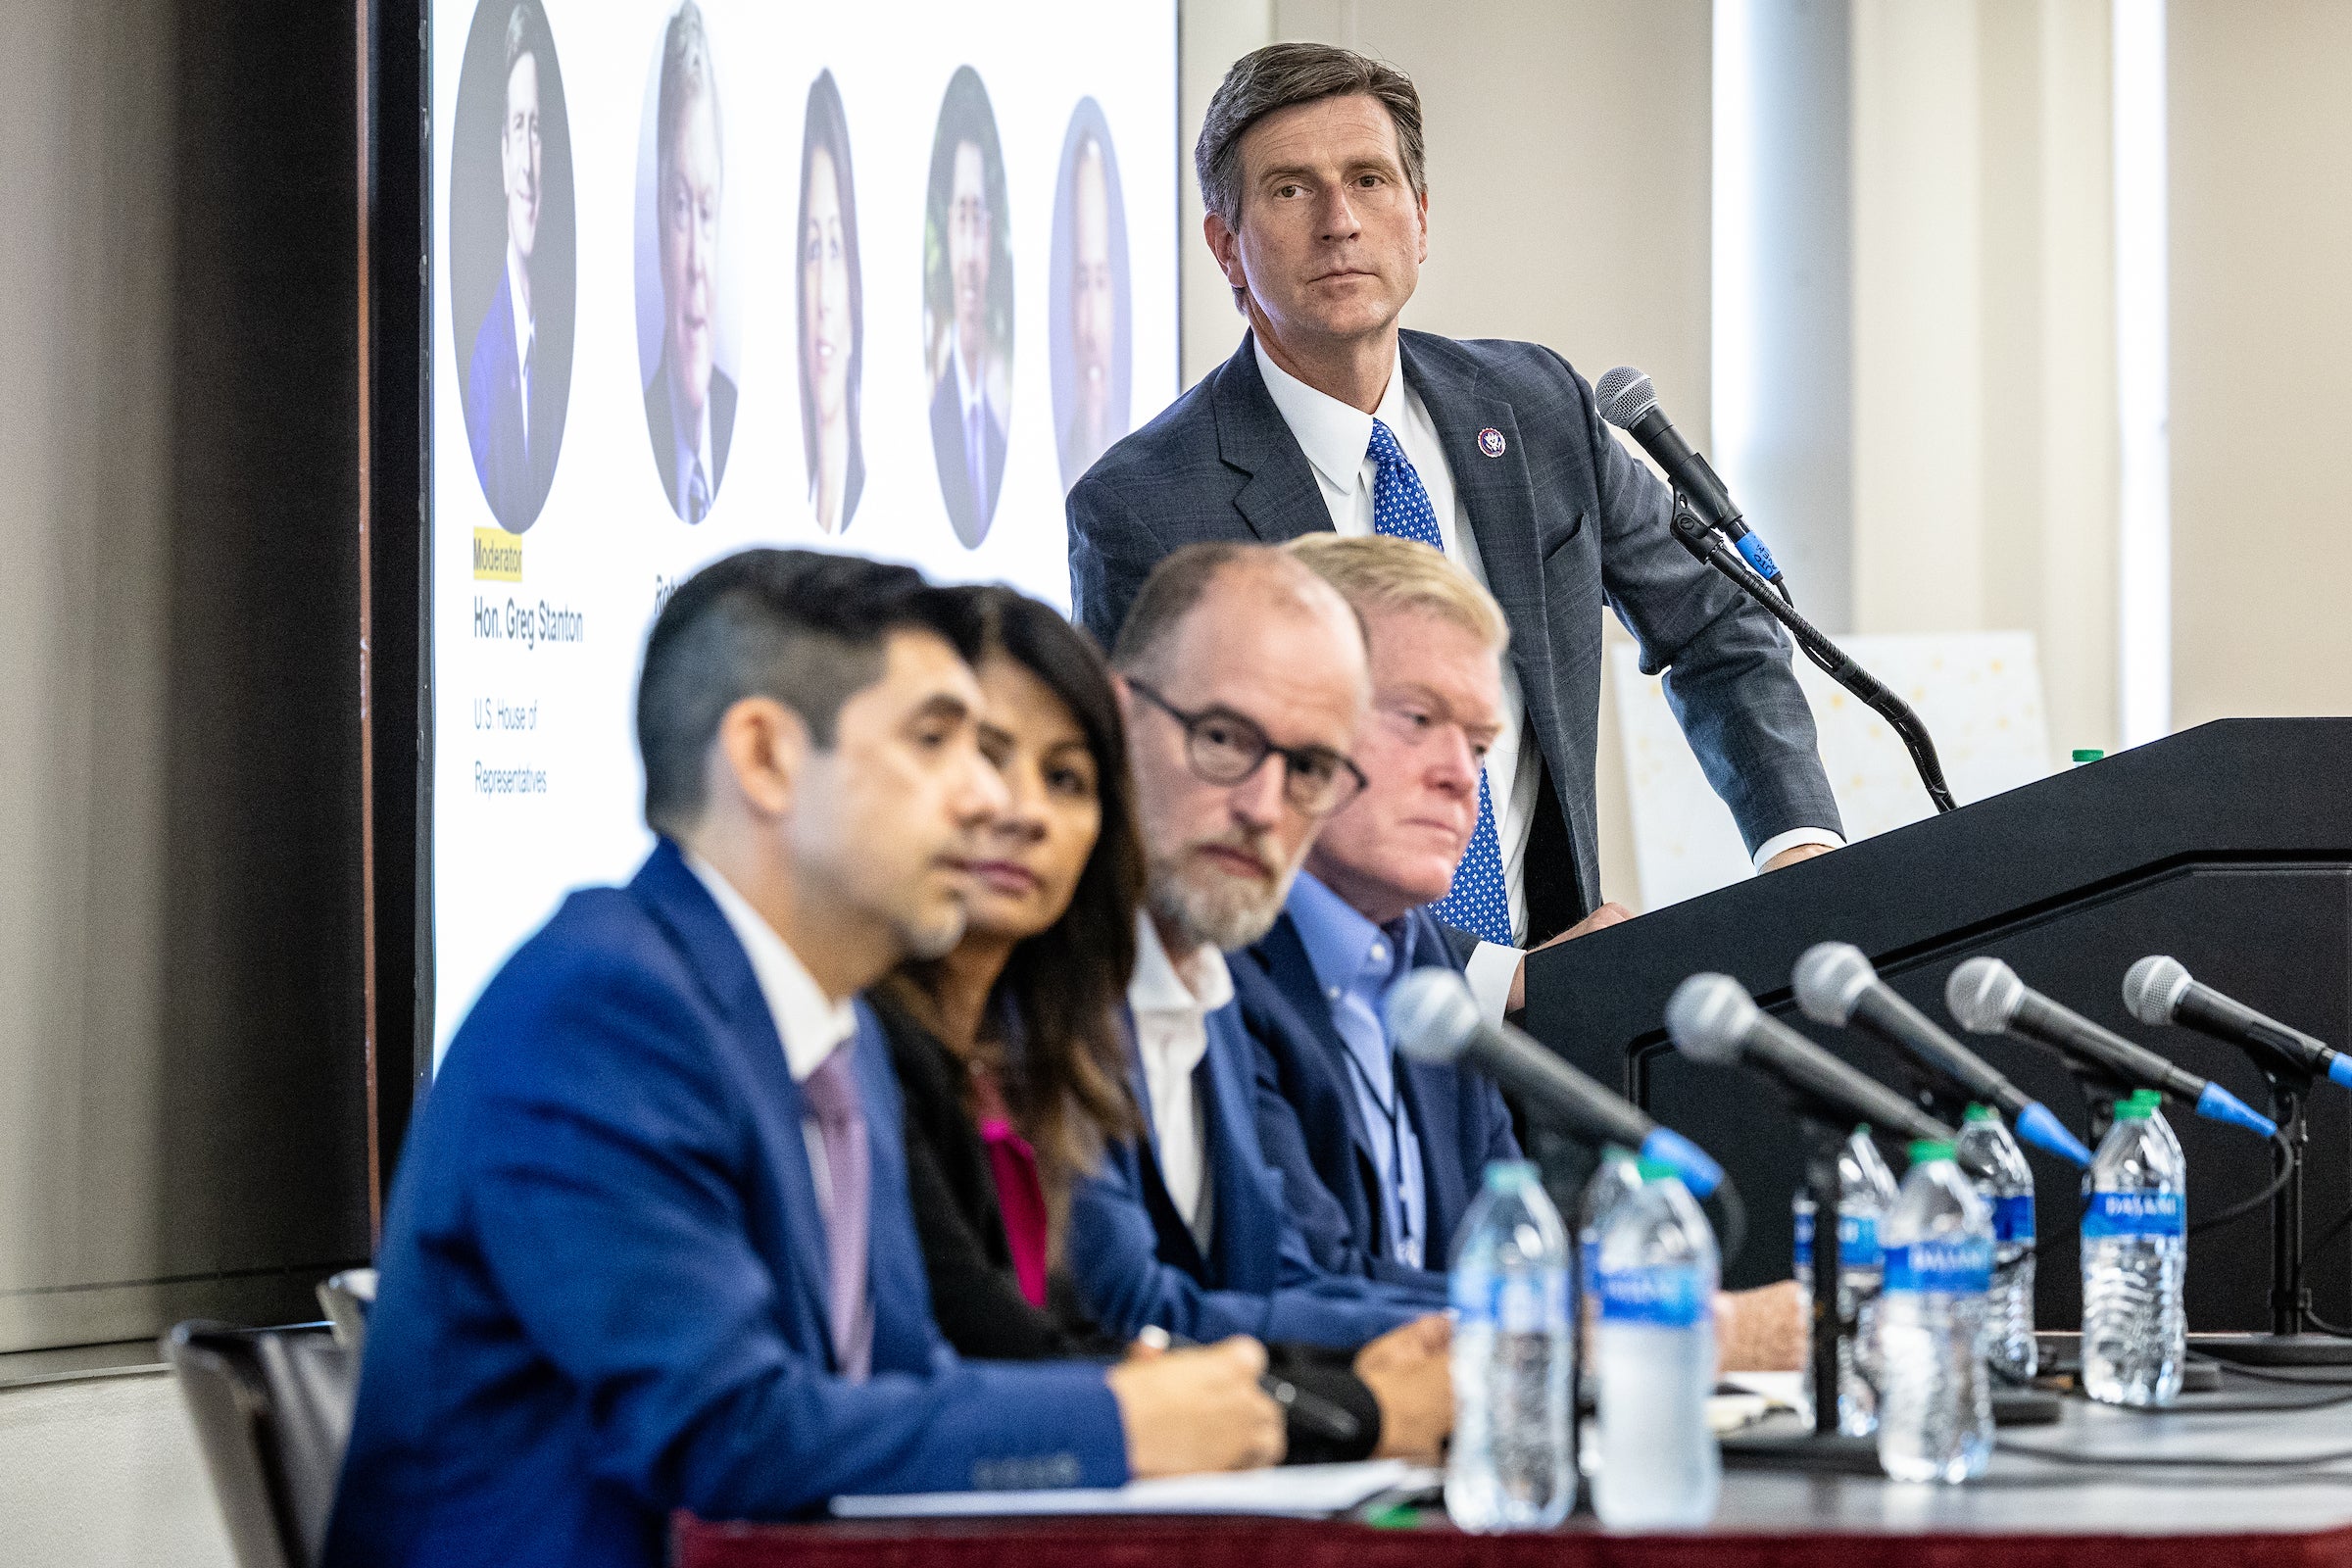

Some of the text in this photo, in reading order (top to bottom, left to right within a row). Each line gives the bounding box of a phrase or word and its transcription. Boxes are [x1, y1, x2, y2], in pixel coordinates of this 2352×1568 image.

[473, 537, 522, 573] Moderator
[474, 595, 584, 651] Hon. Greg Stanton
[474, 697, 538, 730] U.S. House of
[474, 760, 548, 801] Representatives
